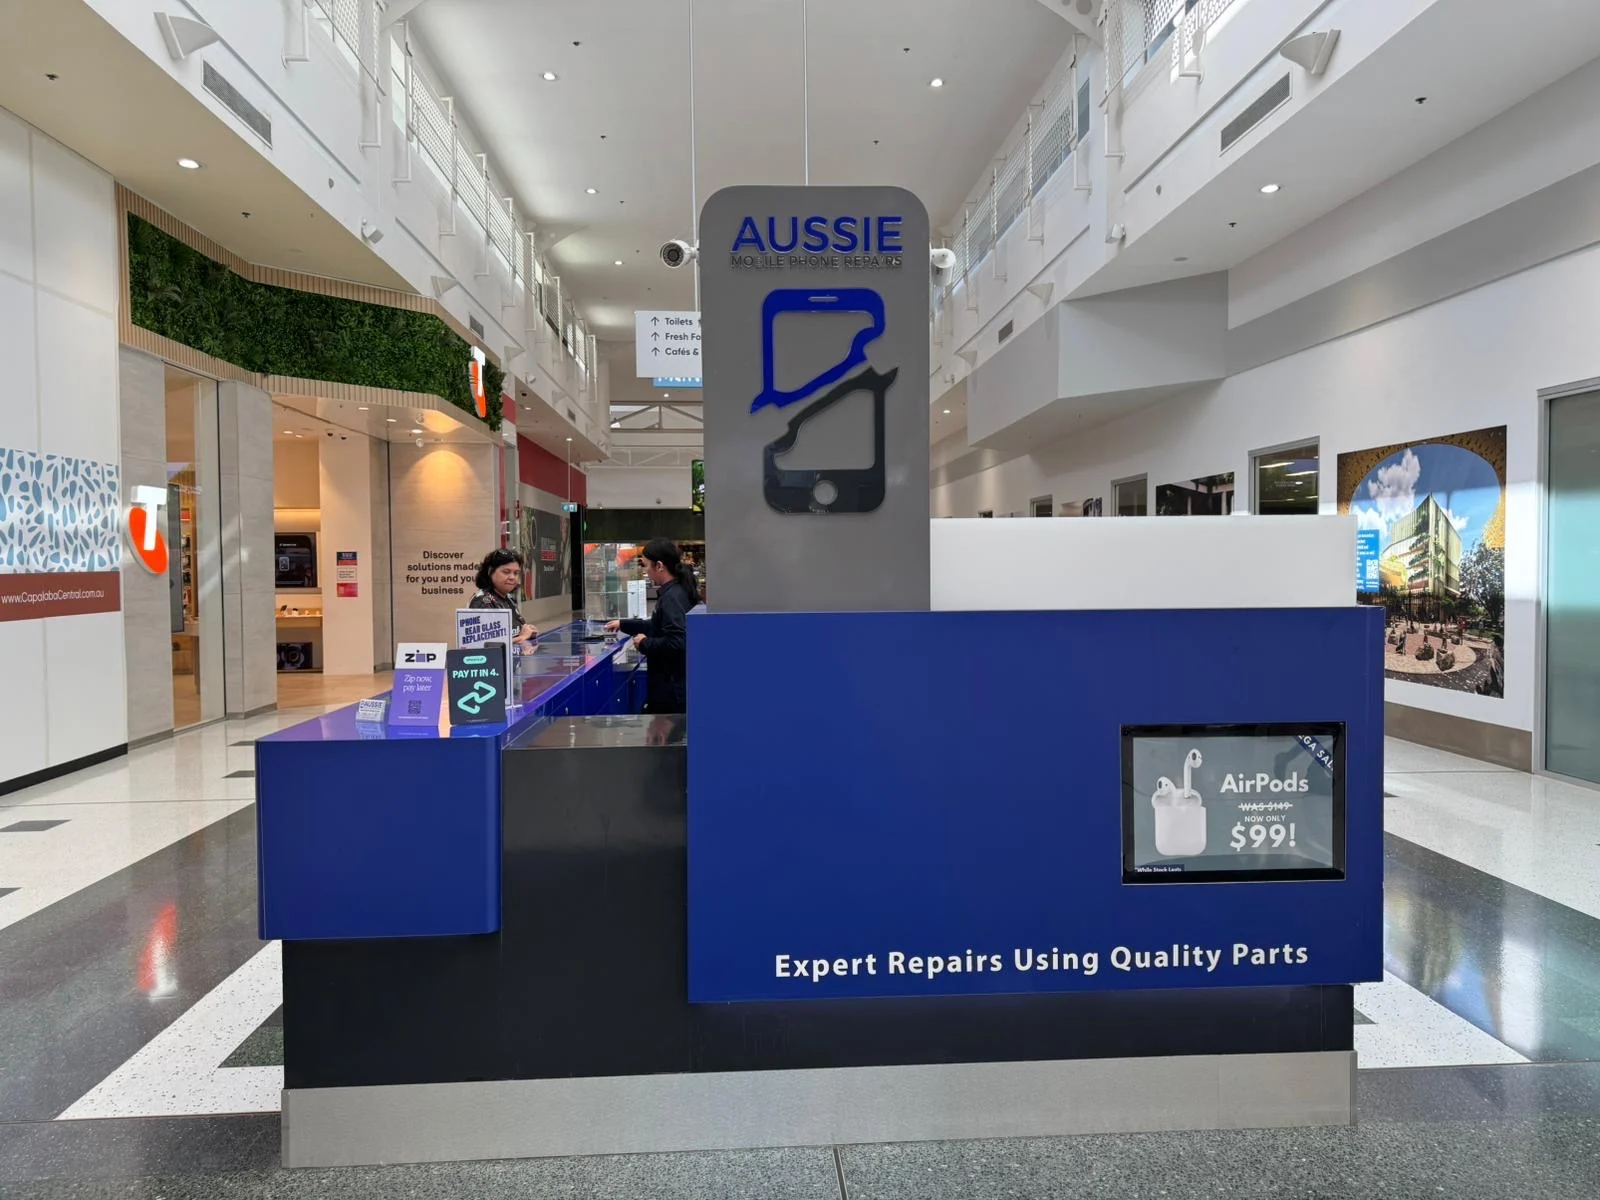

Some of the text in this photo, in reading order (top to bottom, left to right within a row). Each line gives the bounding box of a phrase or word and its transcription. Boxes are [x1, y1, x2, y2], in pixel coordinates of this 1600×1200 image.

[730, 216, 903, 253] AUSSIE
[789, 255, 839, 268] PHONE
[843, 255, 903, 268] REPAIRS
[664, 317, 693, 326] Toilets
[665, 332, 701, 341] Fresh Fo
[664, 347, 699, 356] Cafés &
[423, 550, 464, 559] Discover
[407, 562, 482, 571] solutions made
[406, 574, 477, 585] for you and you
[1, 588, 105, 604] www.CapalabaCentral.com.au
[421, 586, 465, 595] business
[465, 620, 501, 636] REAR GLASS
[462, 627, 507, 645] REPLACEMENT!
[452, 668, 500, 679] PAY IT IN 4.
[1298, 735, 1334, 771] GA SAL
[1219, 771, 1309, 793] AirPods
[1240, 802, 1265, 811] WAS
[1244, 814, 1286, 823] NOW ONLY
[1229, 821, 1296, 852] $99!
[775, 943, 1308, 983] Expert Repairs Using Quality Parts
